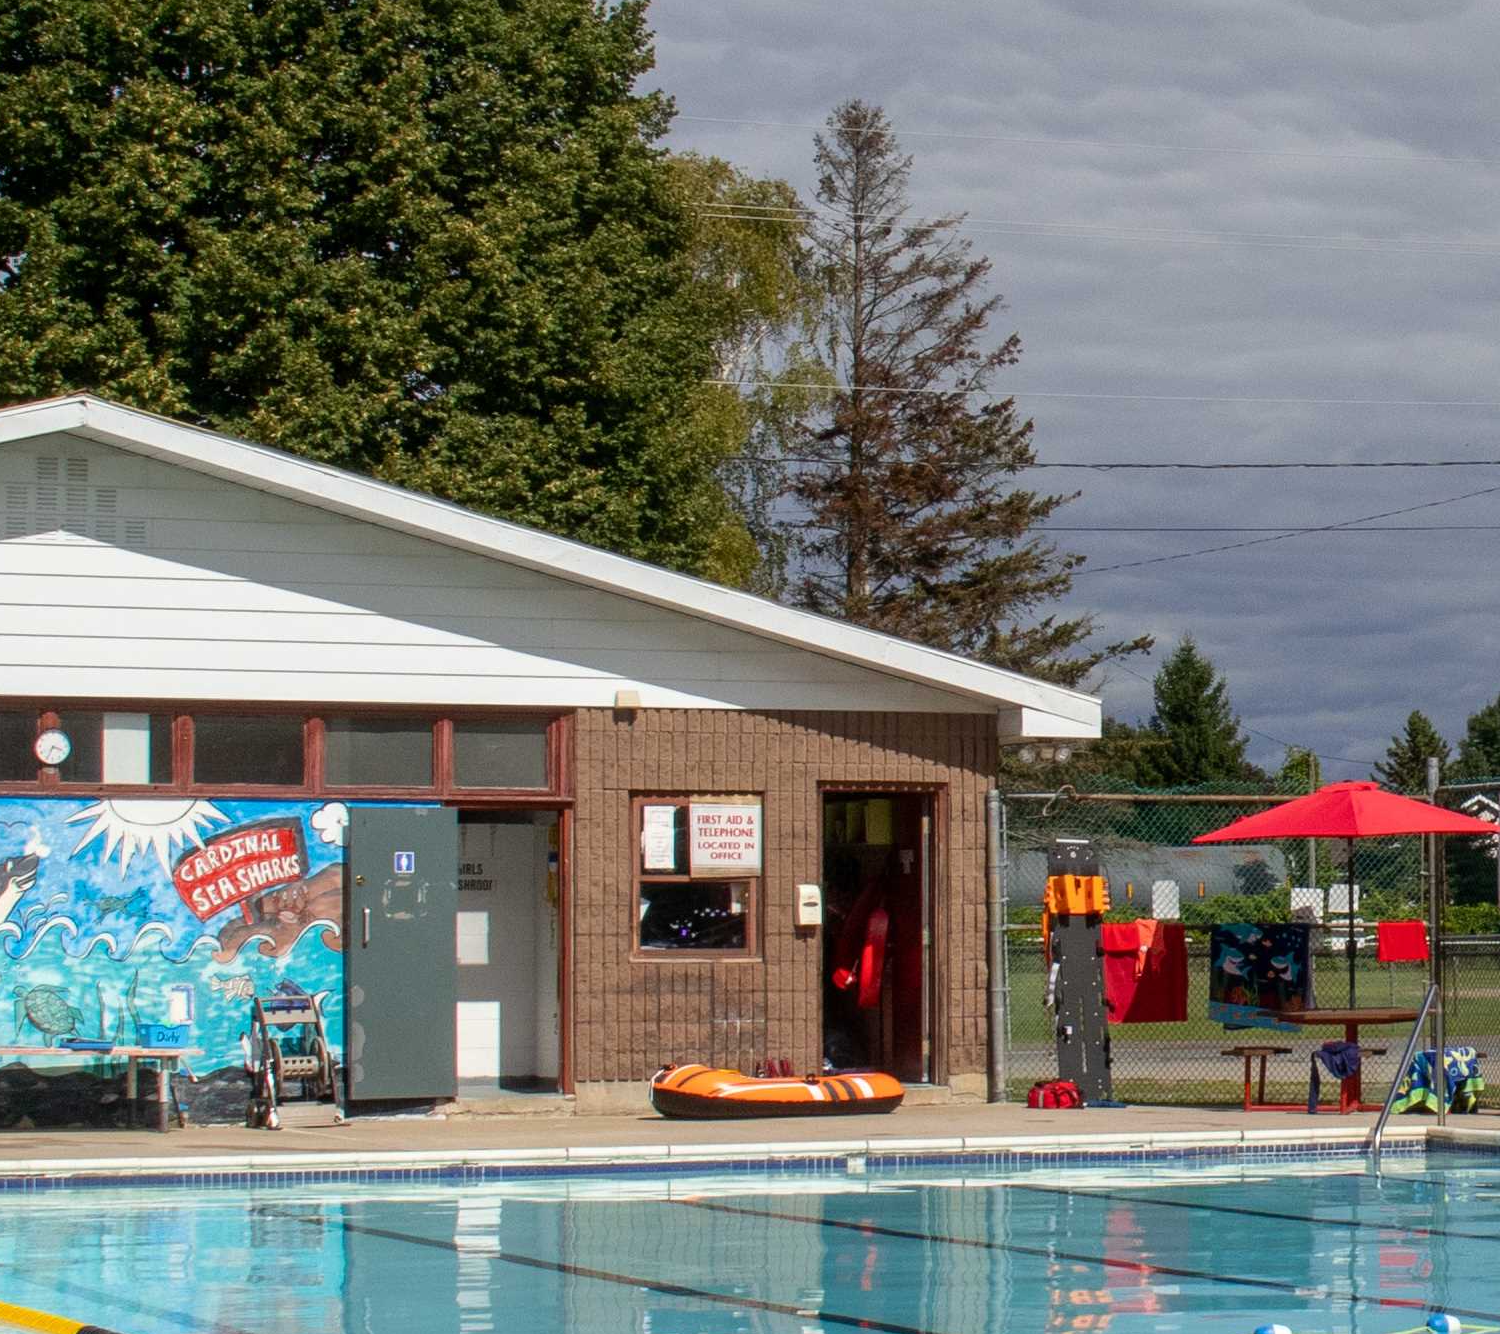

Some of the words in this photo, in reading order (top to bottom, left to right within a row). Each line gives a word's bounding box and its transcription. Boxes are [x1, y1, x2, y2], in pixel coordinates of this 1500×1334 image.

[697, 814, 721, 825] FIRST
[726, 814, 743, 825] AID
[746, 814, 754, 825] &
[698, 827, 755, 837] TELEPHONE
[697, 841, 741, 850] LOCATED
[744, 841, 755, 850] IN
[180, 833, 282, 882] CARDINAL
[710, 851, 742, 860] OFFICE
[192, 876, 237, 912] SEA
[235, 854, 301, 893] SHARKS
[156, 1031, 181, 1044] Dirty
